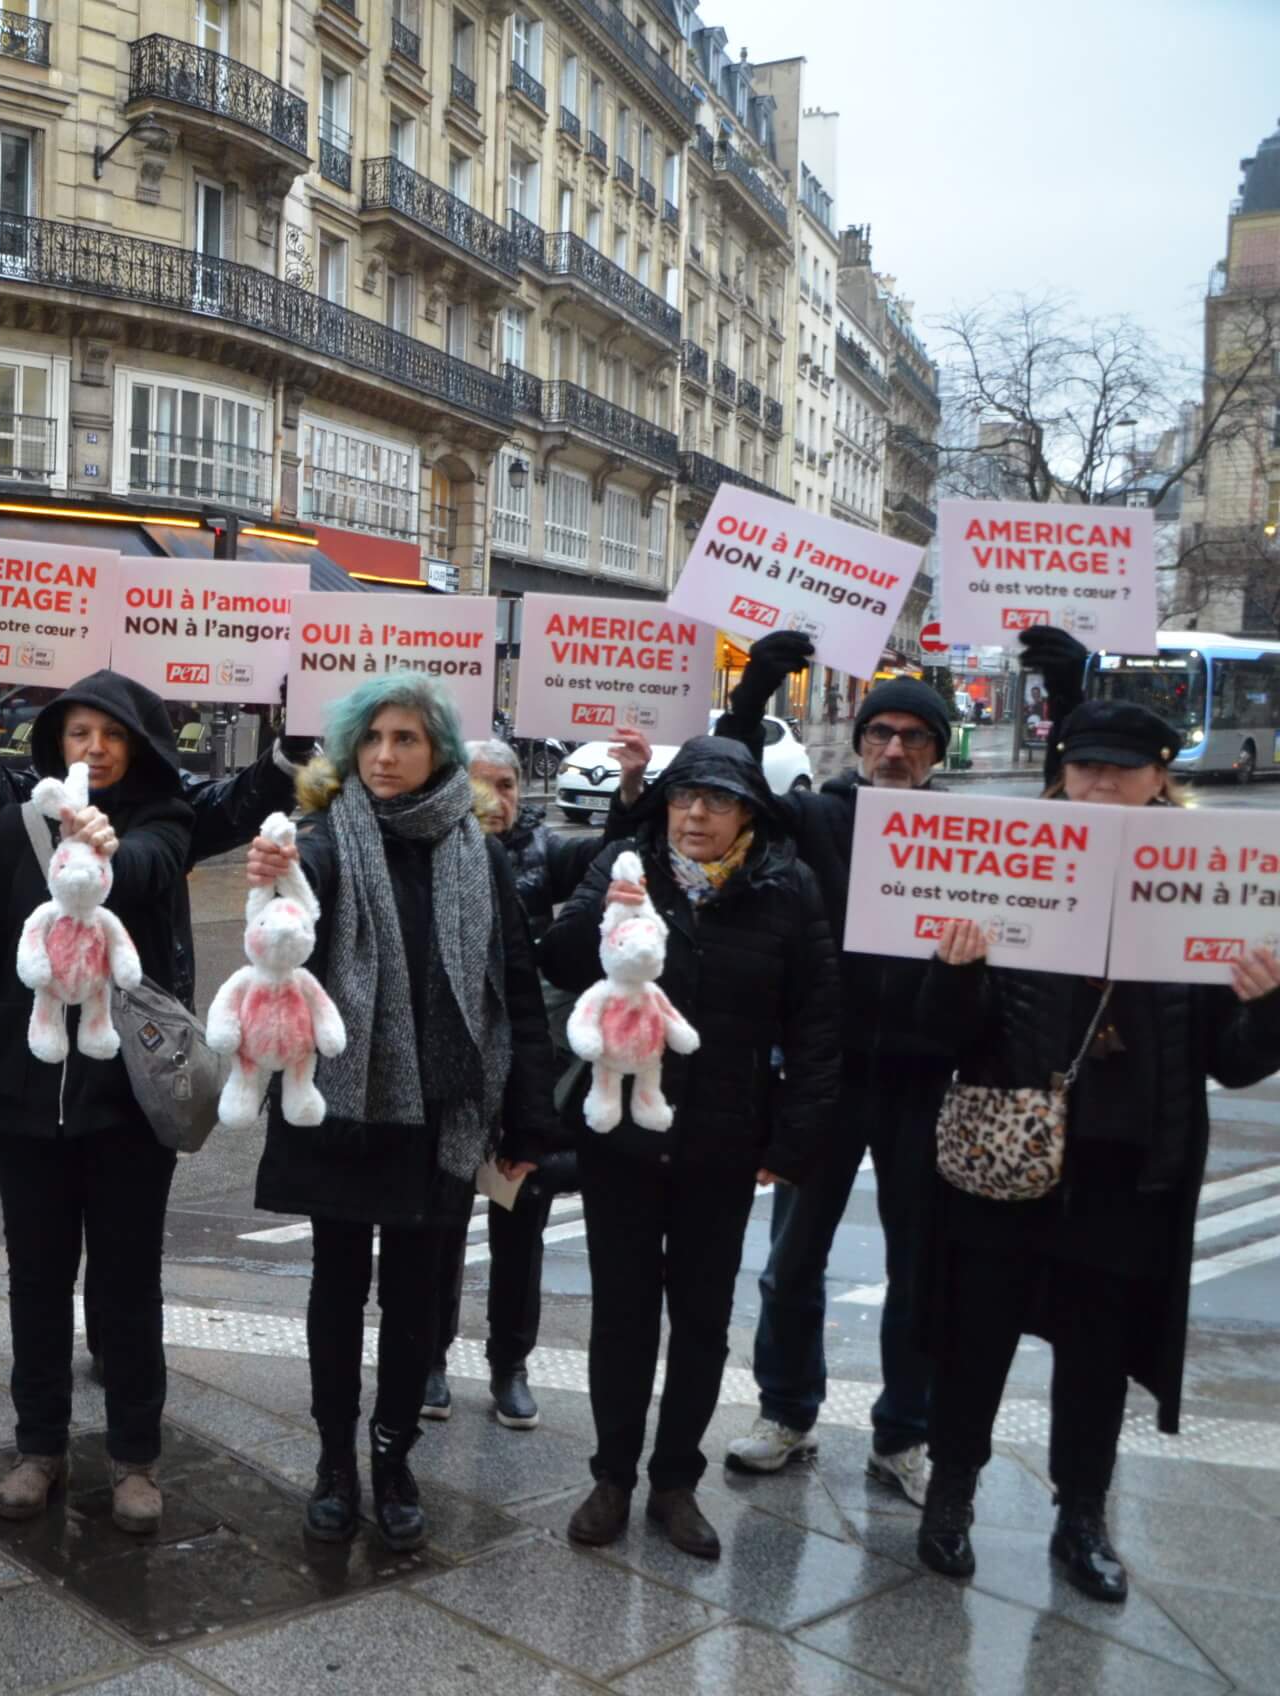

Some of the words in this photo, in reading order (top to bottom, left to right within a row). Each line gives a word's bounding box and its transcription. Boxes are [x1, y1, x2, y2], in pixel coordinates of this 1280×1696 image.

[965, 519, 1132, 548] AMERICAN
[717, 515, 768, 546] OUI
[771, 532, 788, 554] à
[794, 539, 900, 590] l’amour
[973, 546, 1109, 575] VINTAGE
[704, 540, 763, 572] NON
[766, 561, 781, 579] à
[787, 566, 887, 616] l’angora
[969, 580, 990, 592] où
[995, 581, 1021, 595] est
[1026, 584, 1068, 597] votre
[1073, 586, 1117, 599] cœur
[125, 587, 172, 609] OUI
[180, 589, 194, 610] à
[202, 590, 291, 614] l’amou
[35, 624, 76, 638] cœur
[125, 616, 178, 635] NON
[185, 618, 197, 636] à
[302, 623, 350, 645] OUI
[358, 624, 373, 645] à
[382, 625, 483, 648] l’amour
[545, 614, 697, 646] AMERICAN
[301, 652, 355, 672] NON
[363, 654, 376, 673] à
[551, 641, 673, 671] VINTAGE
[545, 674, 563, 687] où
[569, 677, 591, 690] est
[595, 679, 634, 693] votre
[639, 682, 678, 696] cœur
[882, 811, 1089, 852] AMERICAN
[889, 843, 1055, 882] VINTAGE
[1133, 845, 1198, 871] OUI
[1208, 846, 1228, 872] à
[881, 881, 905, 897] où
[911, 884, 941, 900] est
[947, 889, 1000, 905] votre
[1006, 894, 1060, 911] cœur
[1131, 881, 1202, 903] NON
[1213, 883, 1230, 905] à
